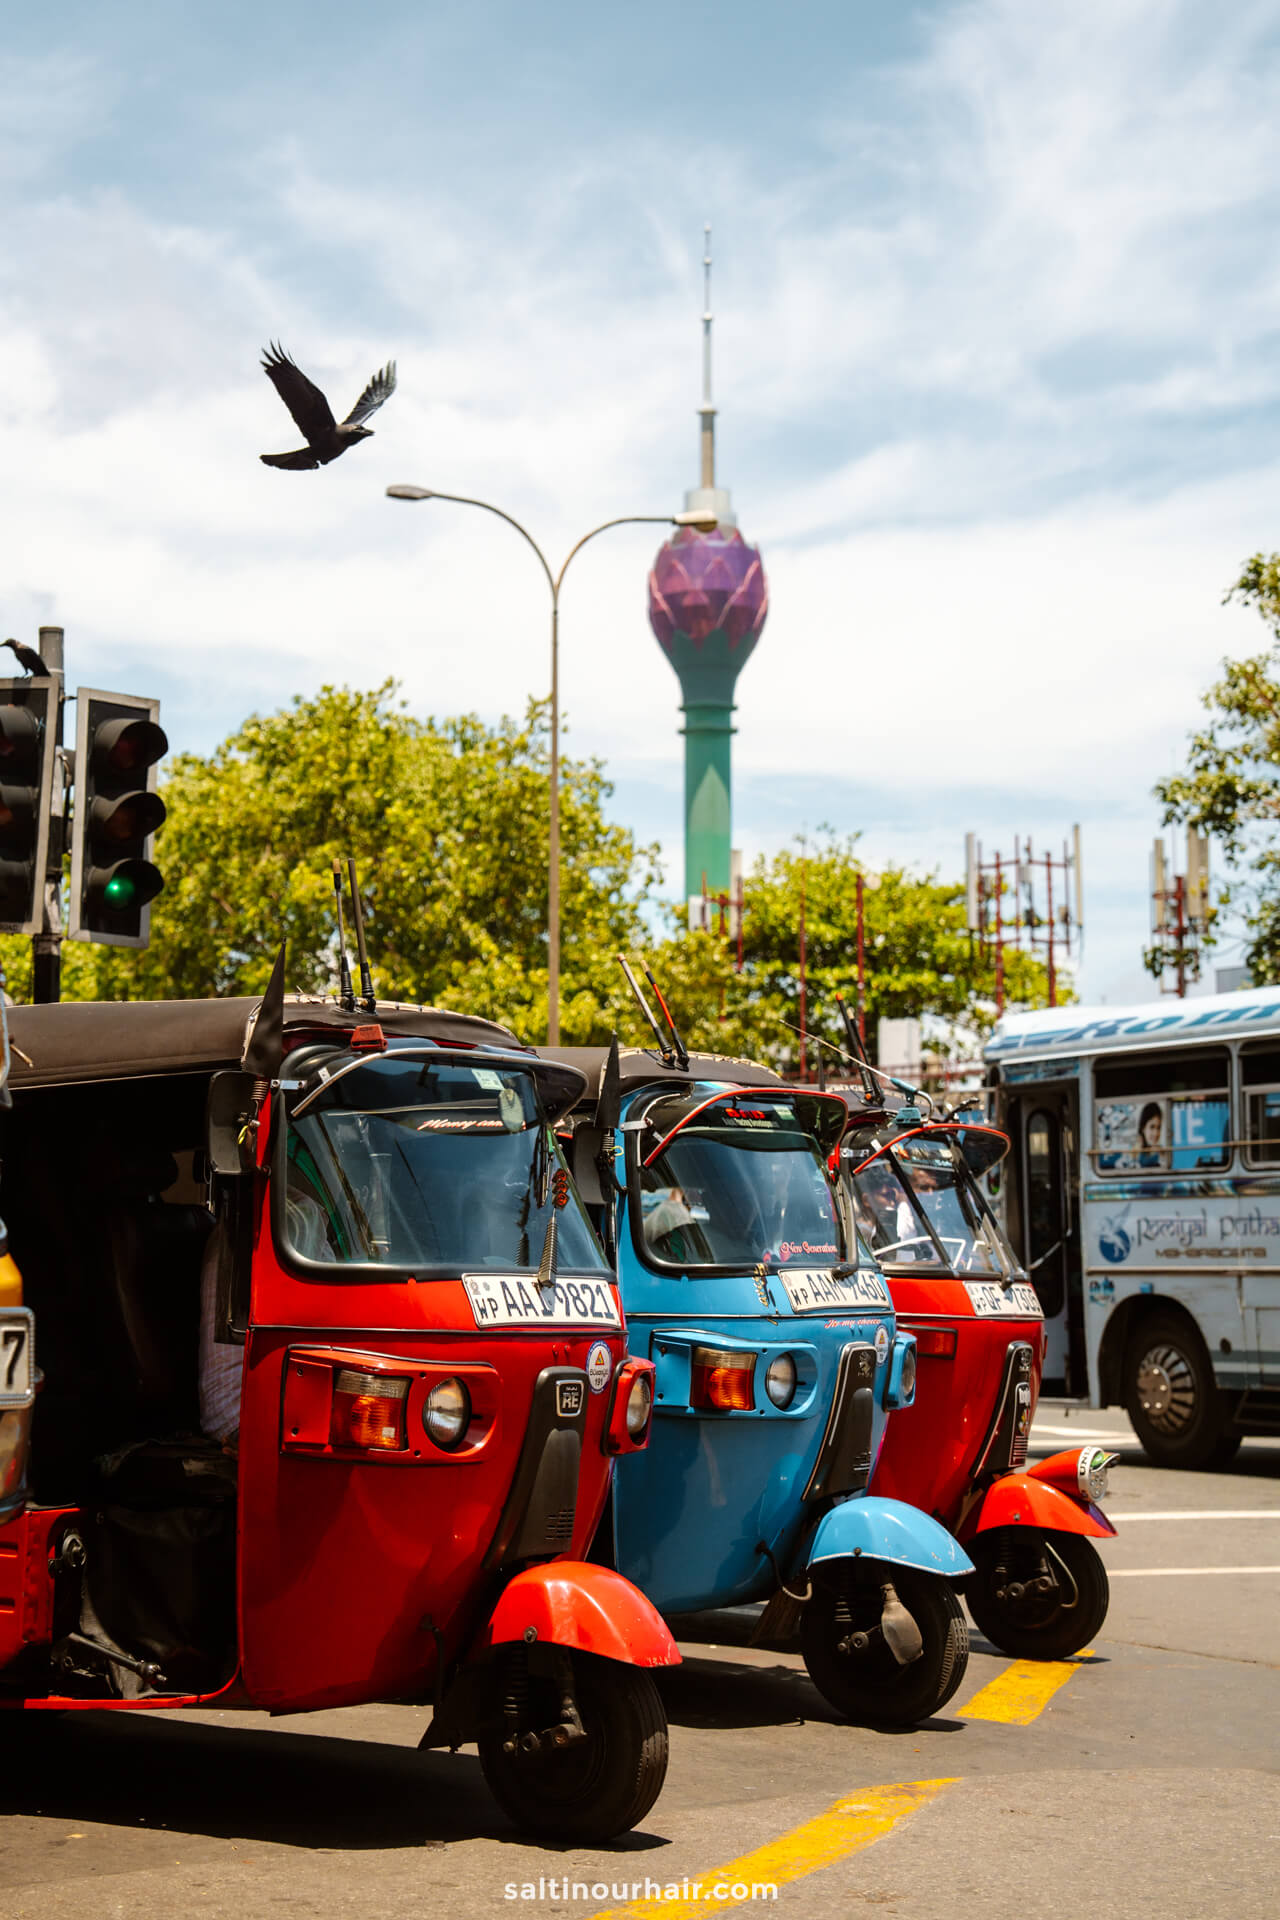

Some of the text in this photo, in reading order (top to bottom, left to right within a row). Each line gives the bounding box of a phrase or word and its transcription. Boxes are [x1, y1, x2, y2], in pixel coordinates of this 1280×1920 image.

[417, 1119, 477, 1131] Money
[780, 1241, 839, 1254] New Generation
[790, 1288, 809, 1306] WP
[475, 1298, 498, 1319] WP
[3, 1329, 25, 1386] 7
[562, 1392, 579, 1409] RE
